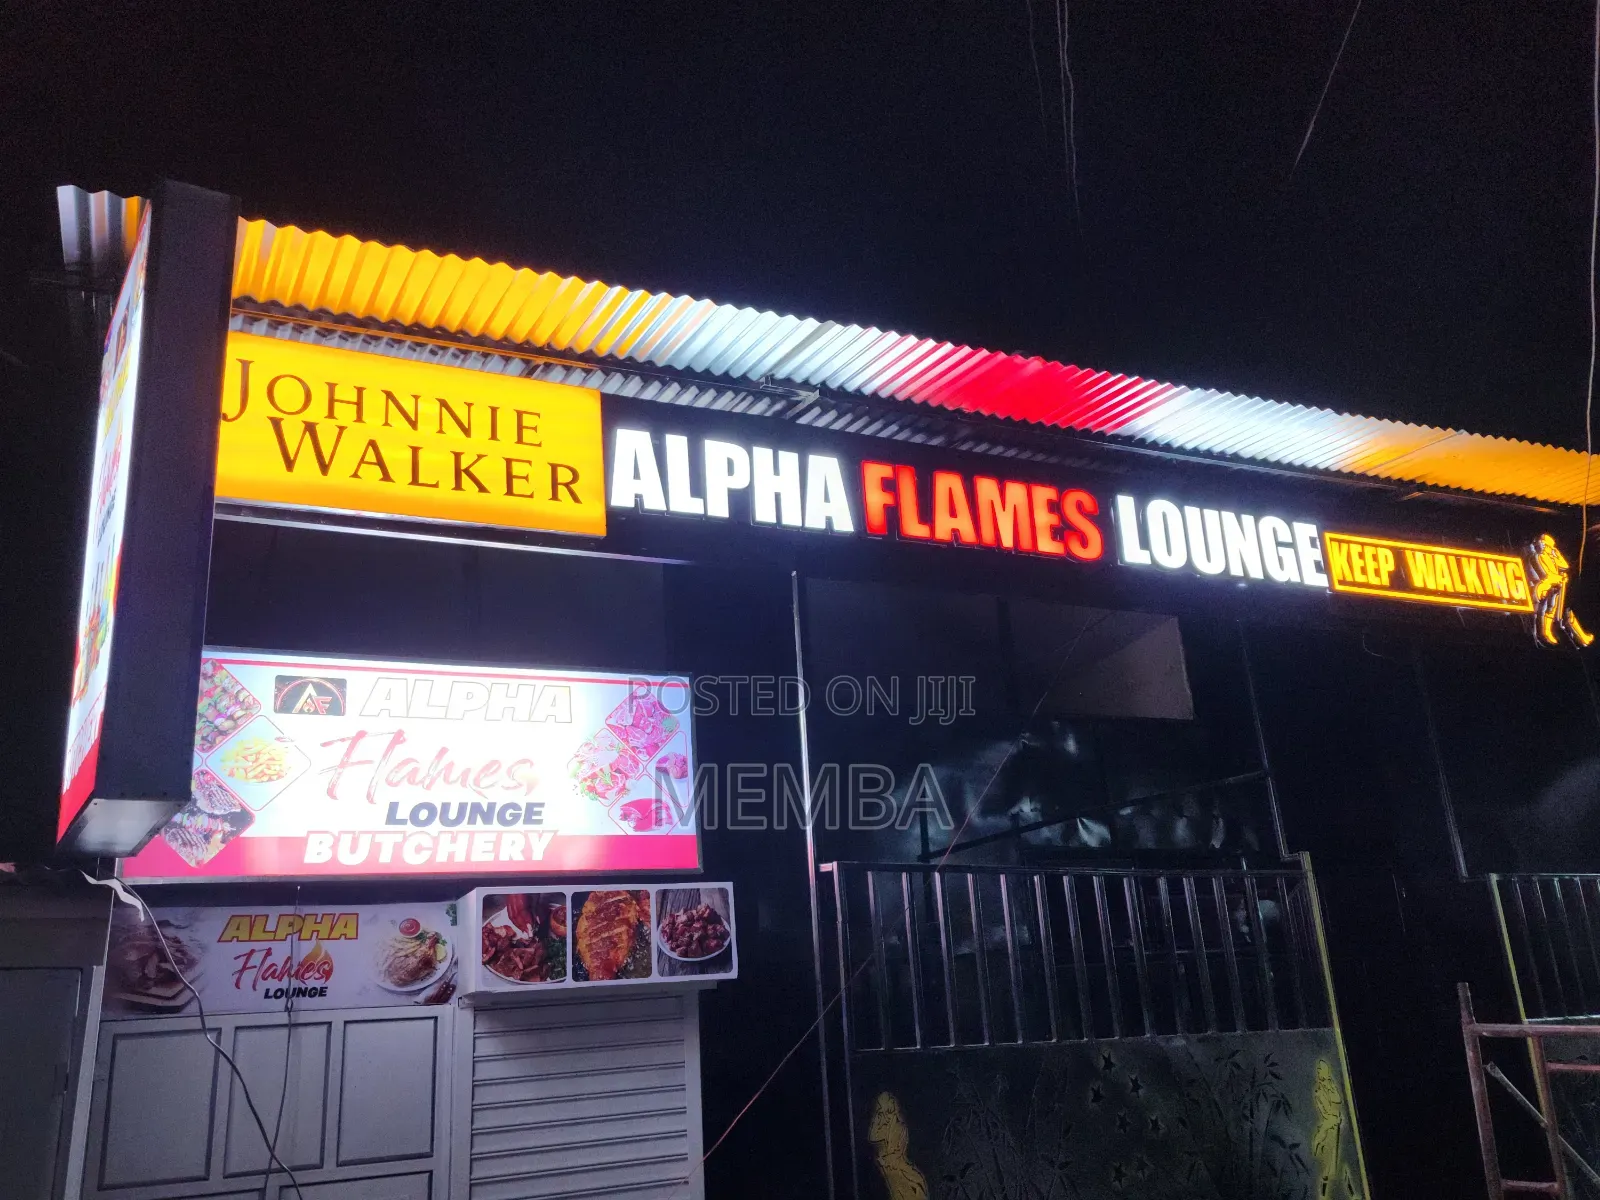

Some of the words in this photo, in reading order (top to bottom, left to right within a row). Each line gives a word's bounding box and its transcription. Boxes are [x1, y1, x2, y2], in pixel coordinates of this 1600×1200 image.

[220, 358, 543, 448] JOHNNIE
[266, 416, 583, 504] WALKER
[610, 428, 855, 533] ALPHA
[861, 460, 1104, 563] FLAMES
[1115, 494, 1328, 588] LOUNGE
[1331, 540, 1395, 587] KEEP
[1404, 549, 1528, 601] WALKING
[359, 677, 573, 724] ALPHA
[317, 729, 539, 803] Flames
[384, 802, 546, 828] LOUNGE
[303, 829, 560, 866] BUTCHERY
[217, 913, 360, 943] ALPHA
[231, 947, 334, 992] Flames
[263, 986, 329, 1000] LOUNGE
